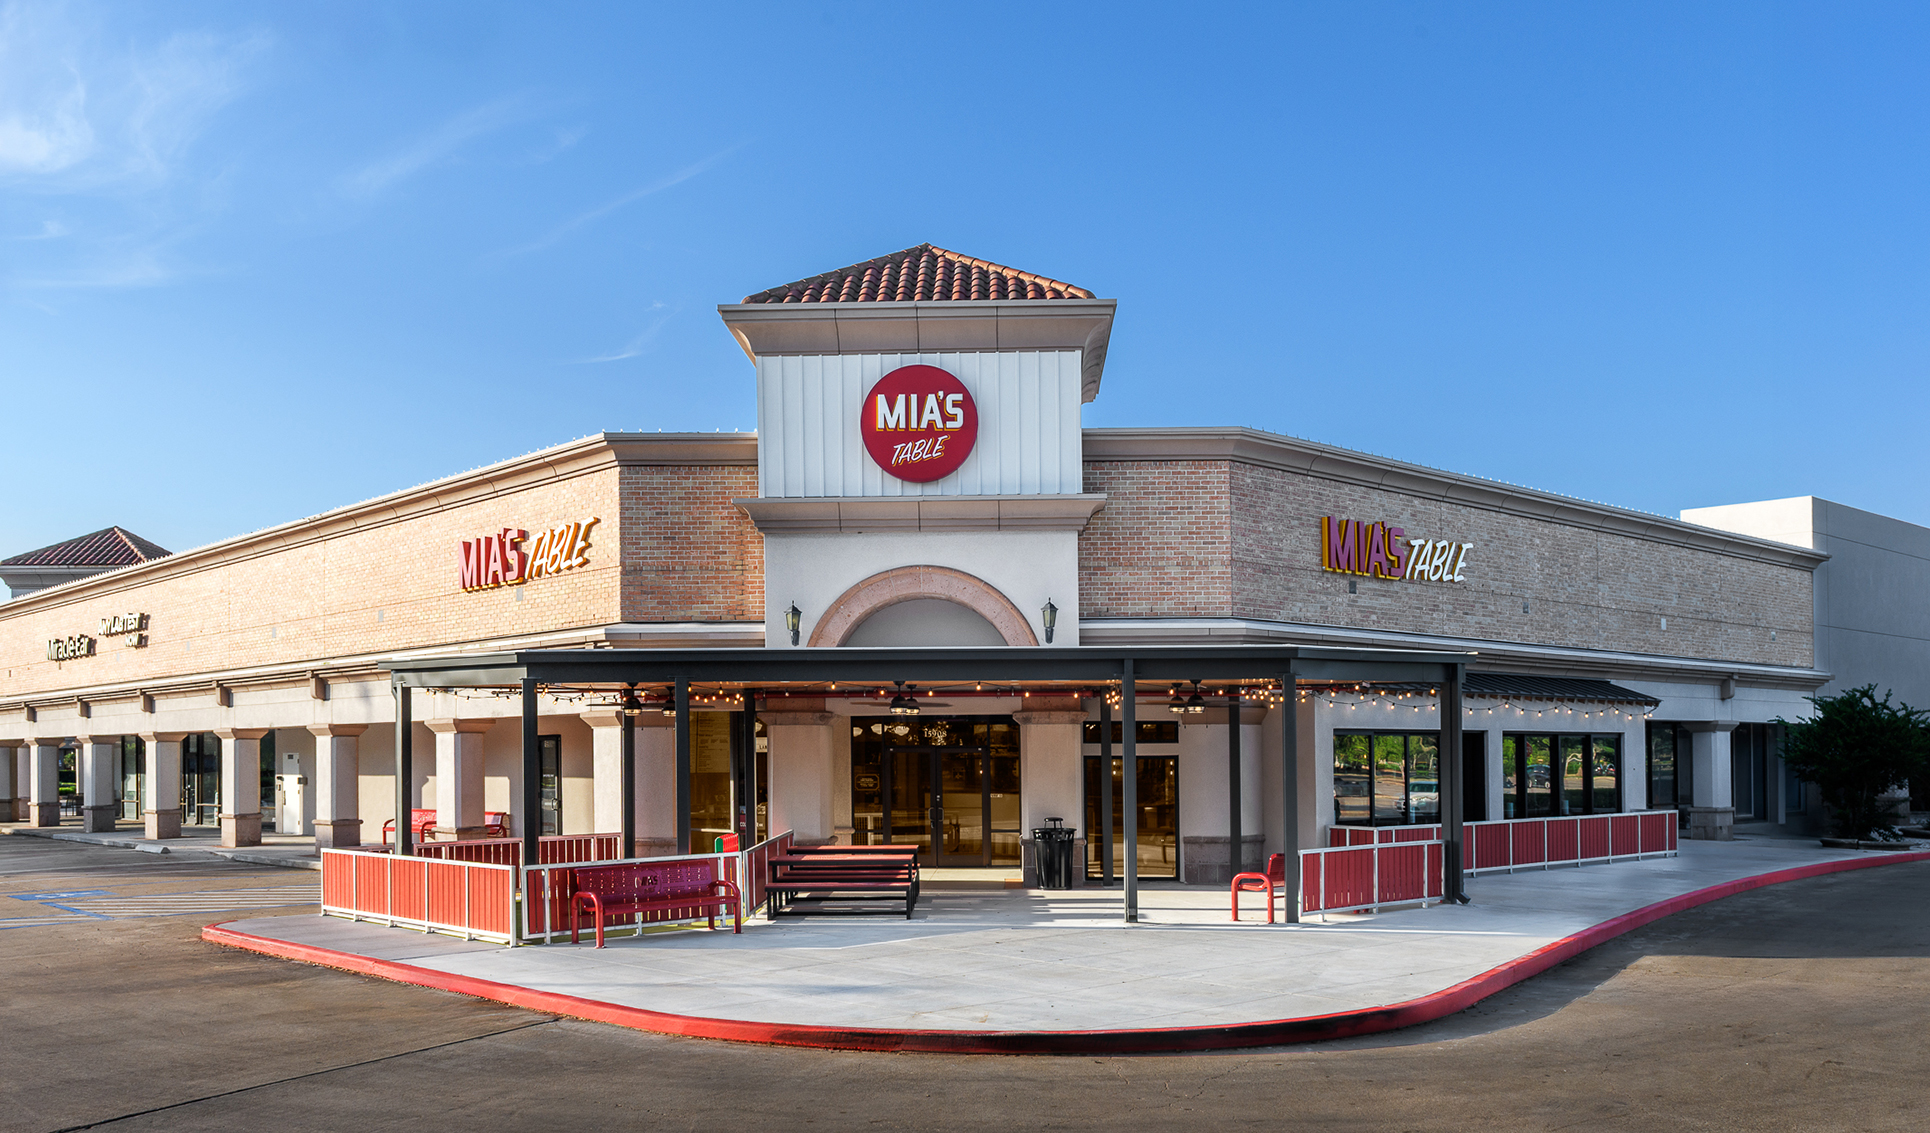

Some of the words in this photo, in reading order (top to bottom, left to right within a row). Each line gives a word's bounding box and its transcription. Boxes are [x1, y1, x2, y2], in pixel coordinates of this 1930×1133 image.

[876, 391, 964, 431] MIA'S
[892, 435, 950, 467] TABLE
[459, 528, 525, 592] MIA'S
[525, 516, 599, 580] TABLE
[1322, 516, 1405, 580] MIA'S
[1404, 539, 1473, 582] TABLE
[98, 618, 112, 636] ANY
[110, 615, 124, 635] LAB
[123, 613, 142, 632] TEST
[125, 634, 139, 647] NOW
